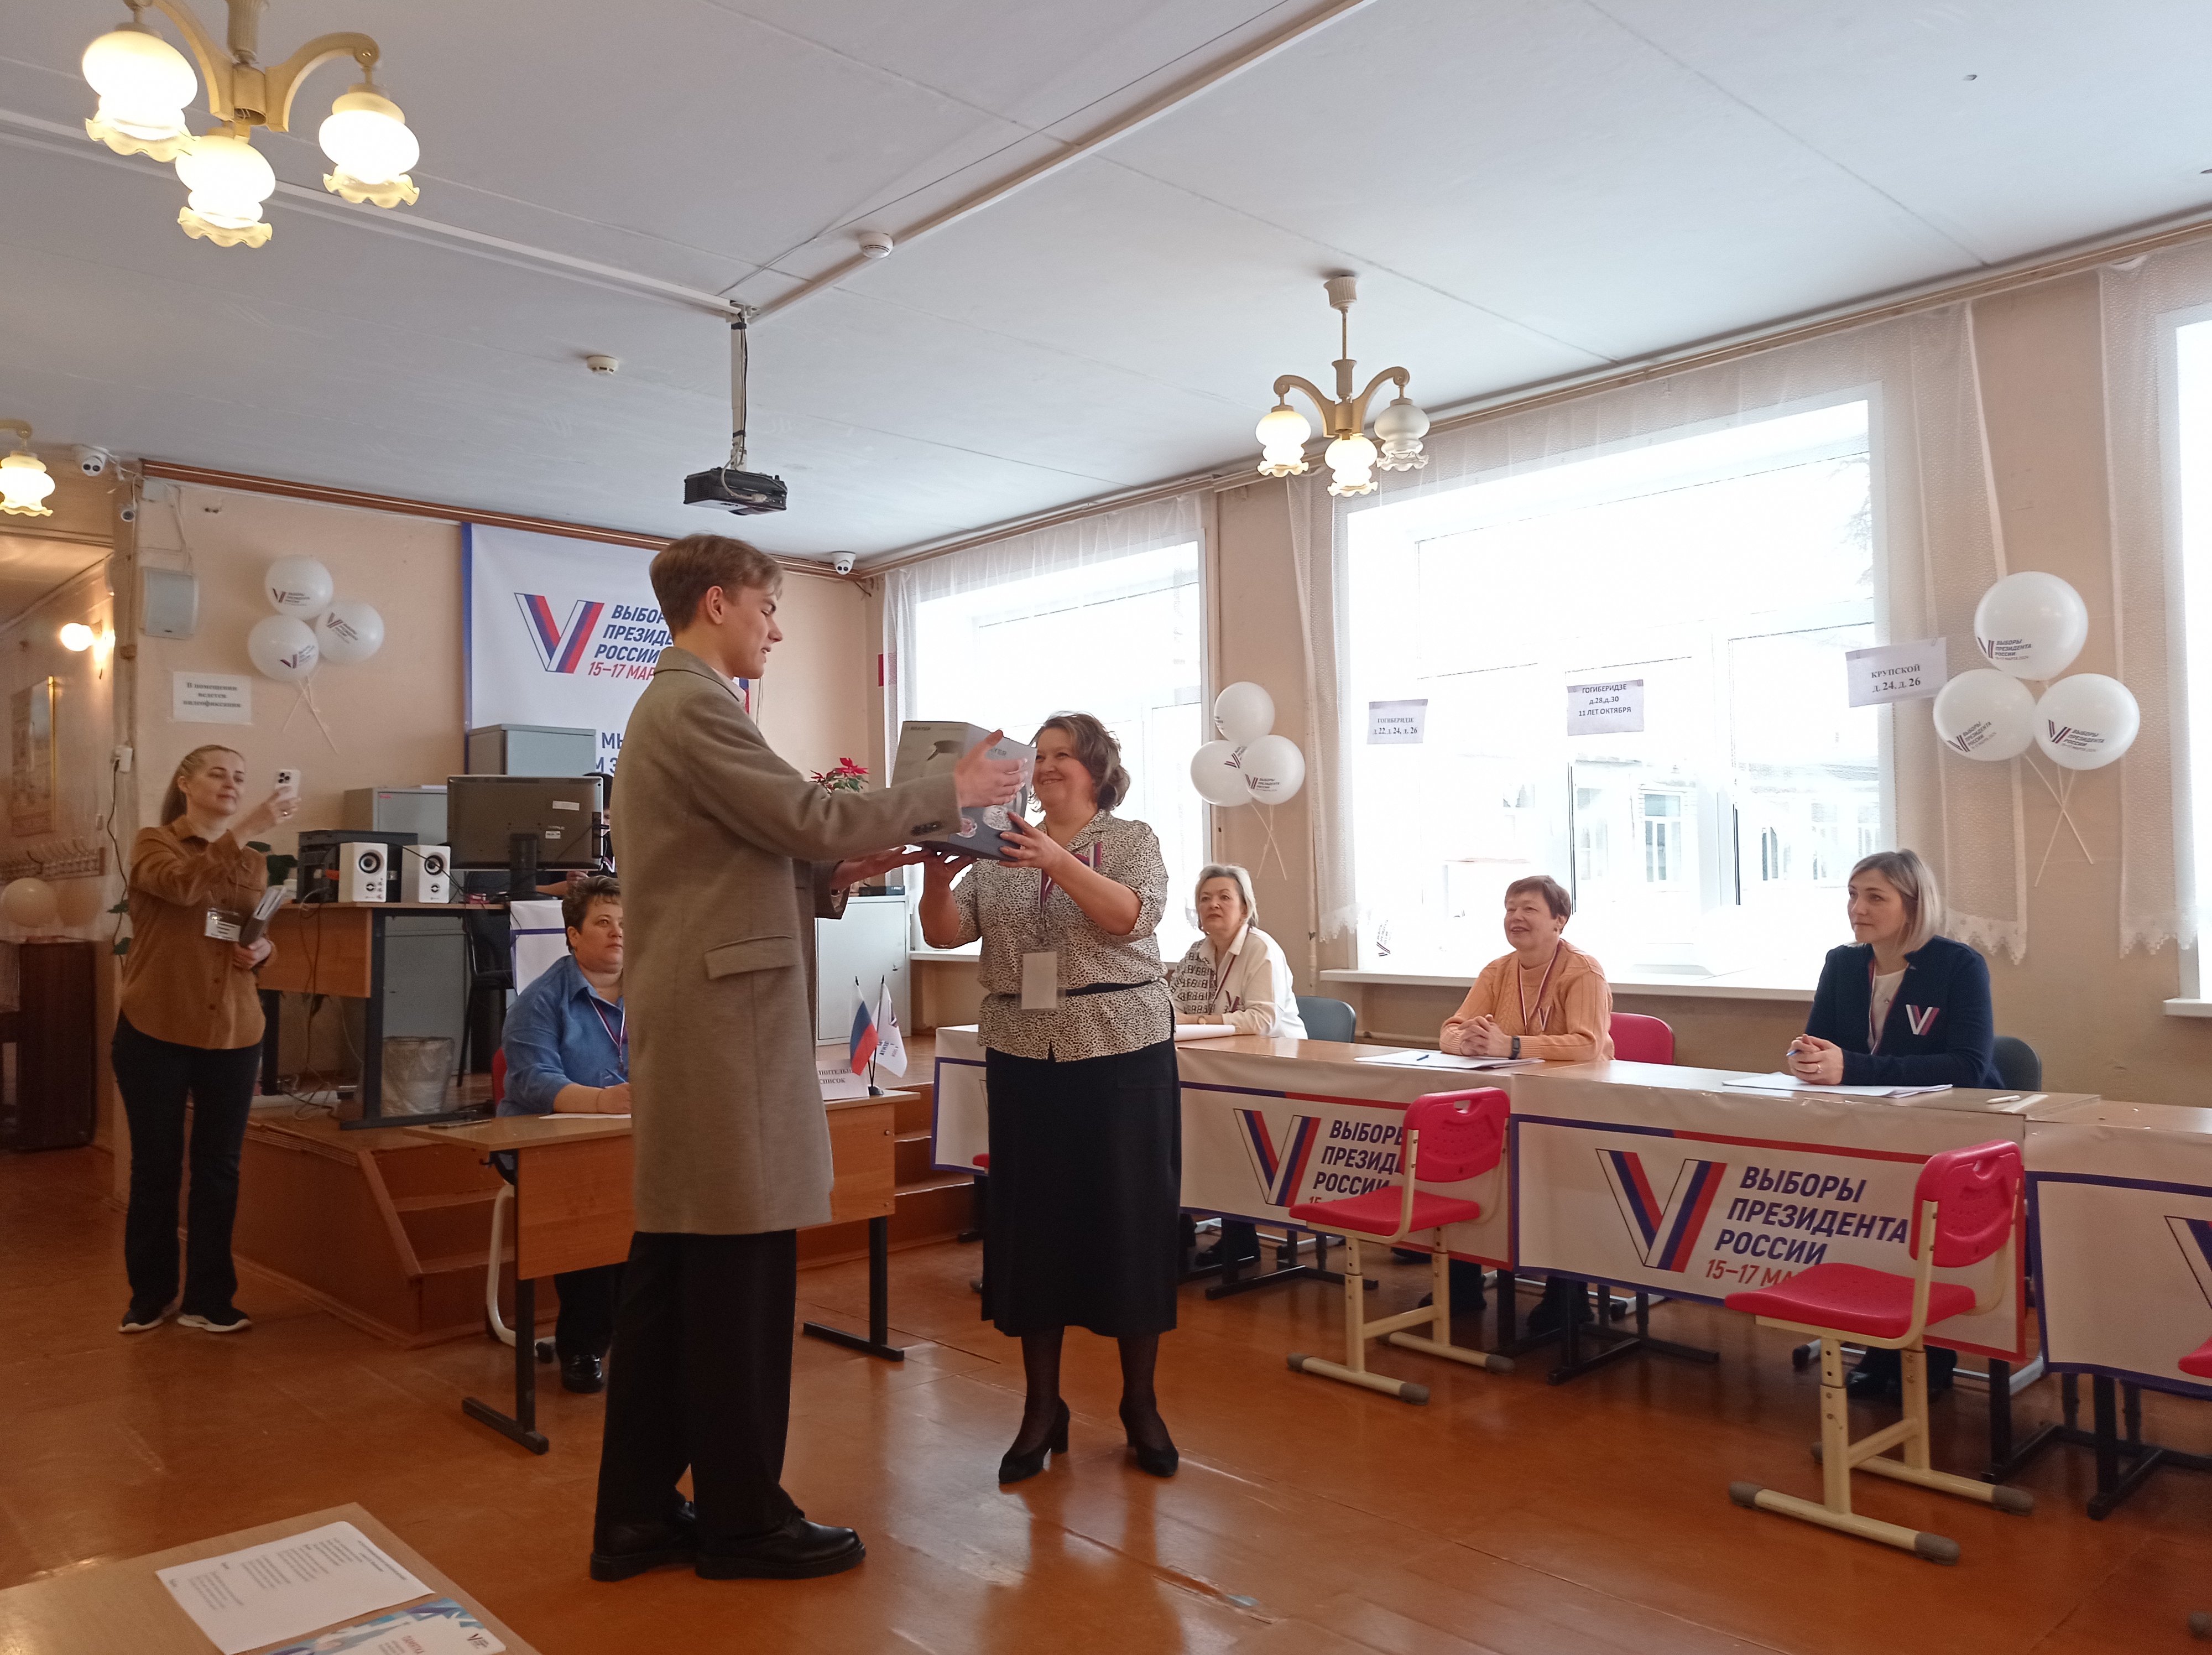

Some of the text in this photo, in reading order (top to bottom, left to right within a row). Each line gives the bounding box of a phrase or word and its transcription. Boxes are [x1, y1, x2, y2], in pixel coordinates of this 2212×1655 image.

[594, 644, 660, 664] РОССИИ
[1871, 664, 1921, 678] КРУПСКОЙ
[1582, 684, 1627, 694] ГОГИБЕРИДЗЕ
[1882, 681, 1897, 690] 24,
[1909, 677, 1921, 687] 26
[1600, 706, 1631, 715] ОКТЯБРЯ
[1740, 1166, 1867, 1203] ВЫБОРЫ
[1727, 1198, 1908, 1243] ПРЕЗИДЕНТА
[1714, 1229, 1828, 1265] РОССИИ
